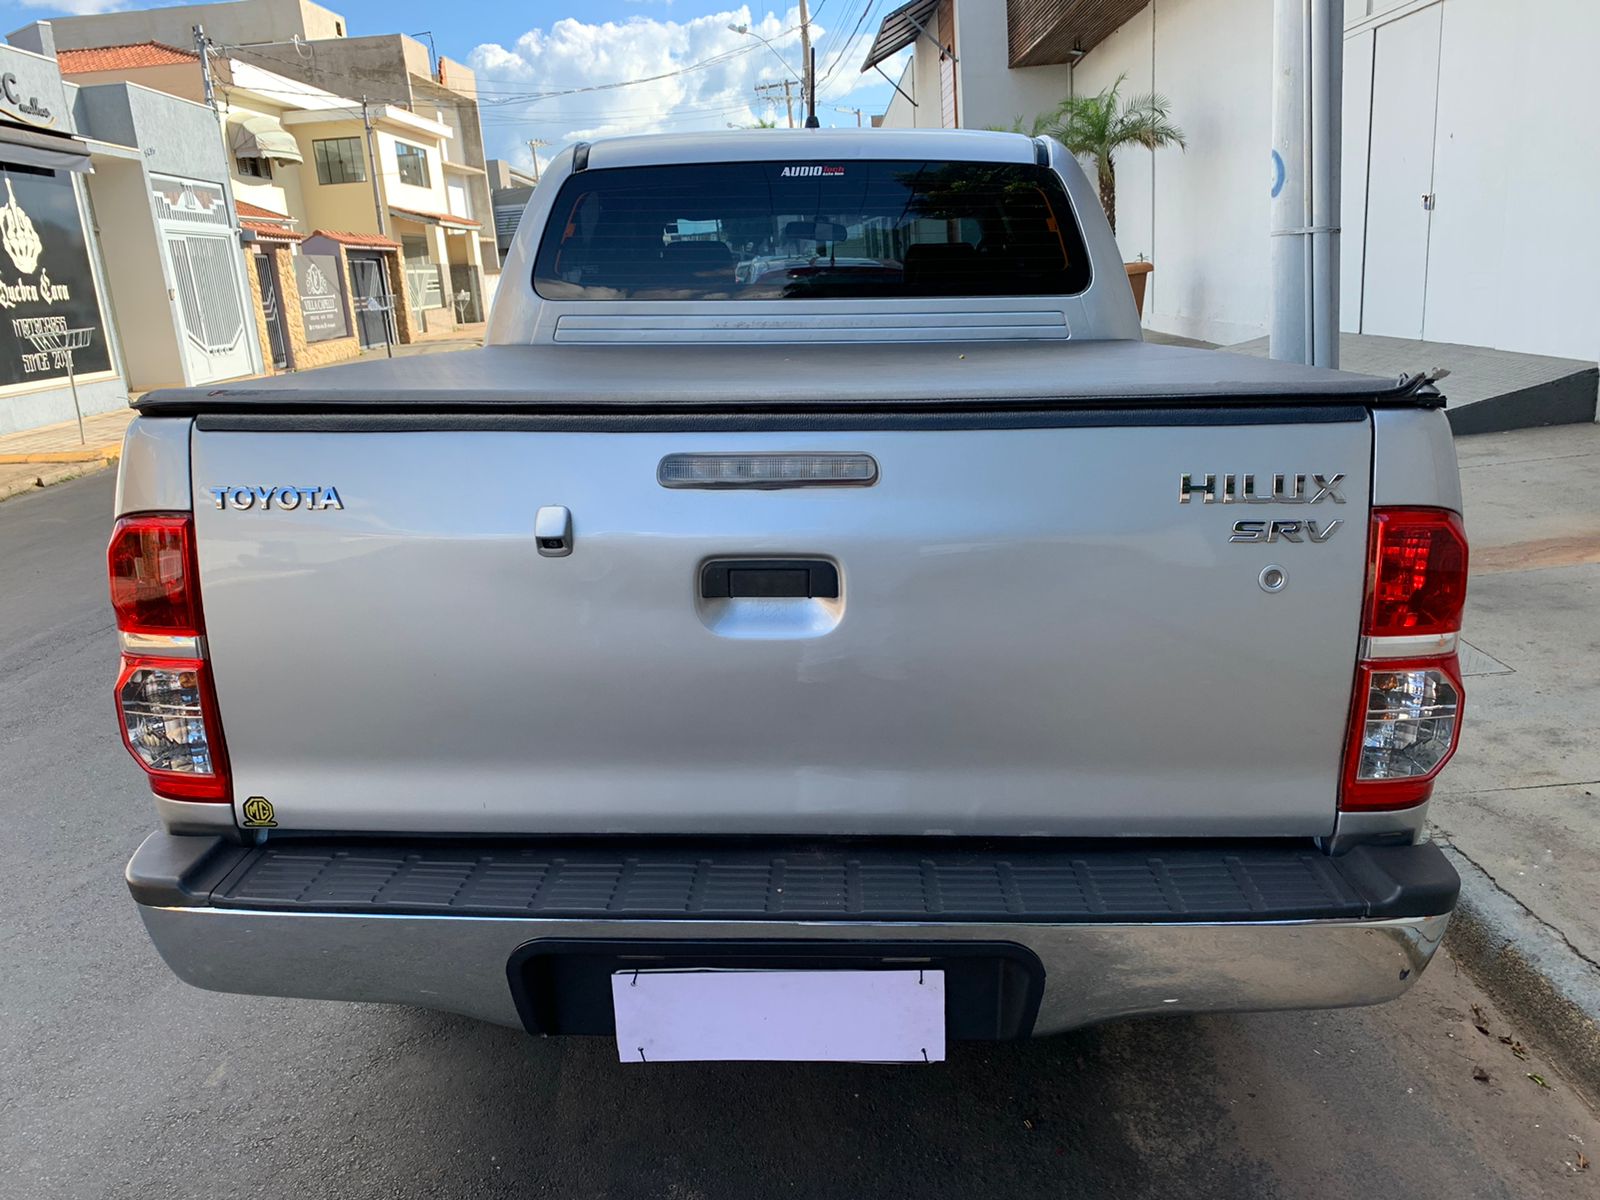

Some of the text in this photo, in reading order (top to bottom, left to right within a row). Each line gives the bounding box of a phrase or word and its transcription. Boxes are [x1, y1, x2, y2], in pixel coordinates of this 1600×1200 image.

[0, 72, 20, 105] C
[781, 166, 822, 176] AUDIO
[22, 352, 50, 373] SINCE
[210, 485, 344, 510] TOYOTA
[1179, 473, 1346, 504] HILUX
[1228, 519, 1345, 543] SRV
[247, 800, 271, 821] MG
